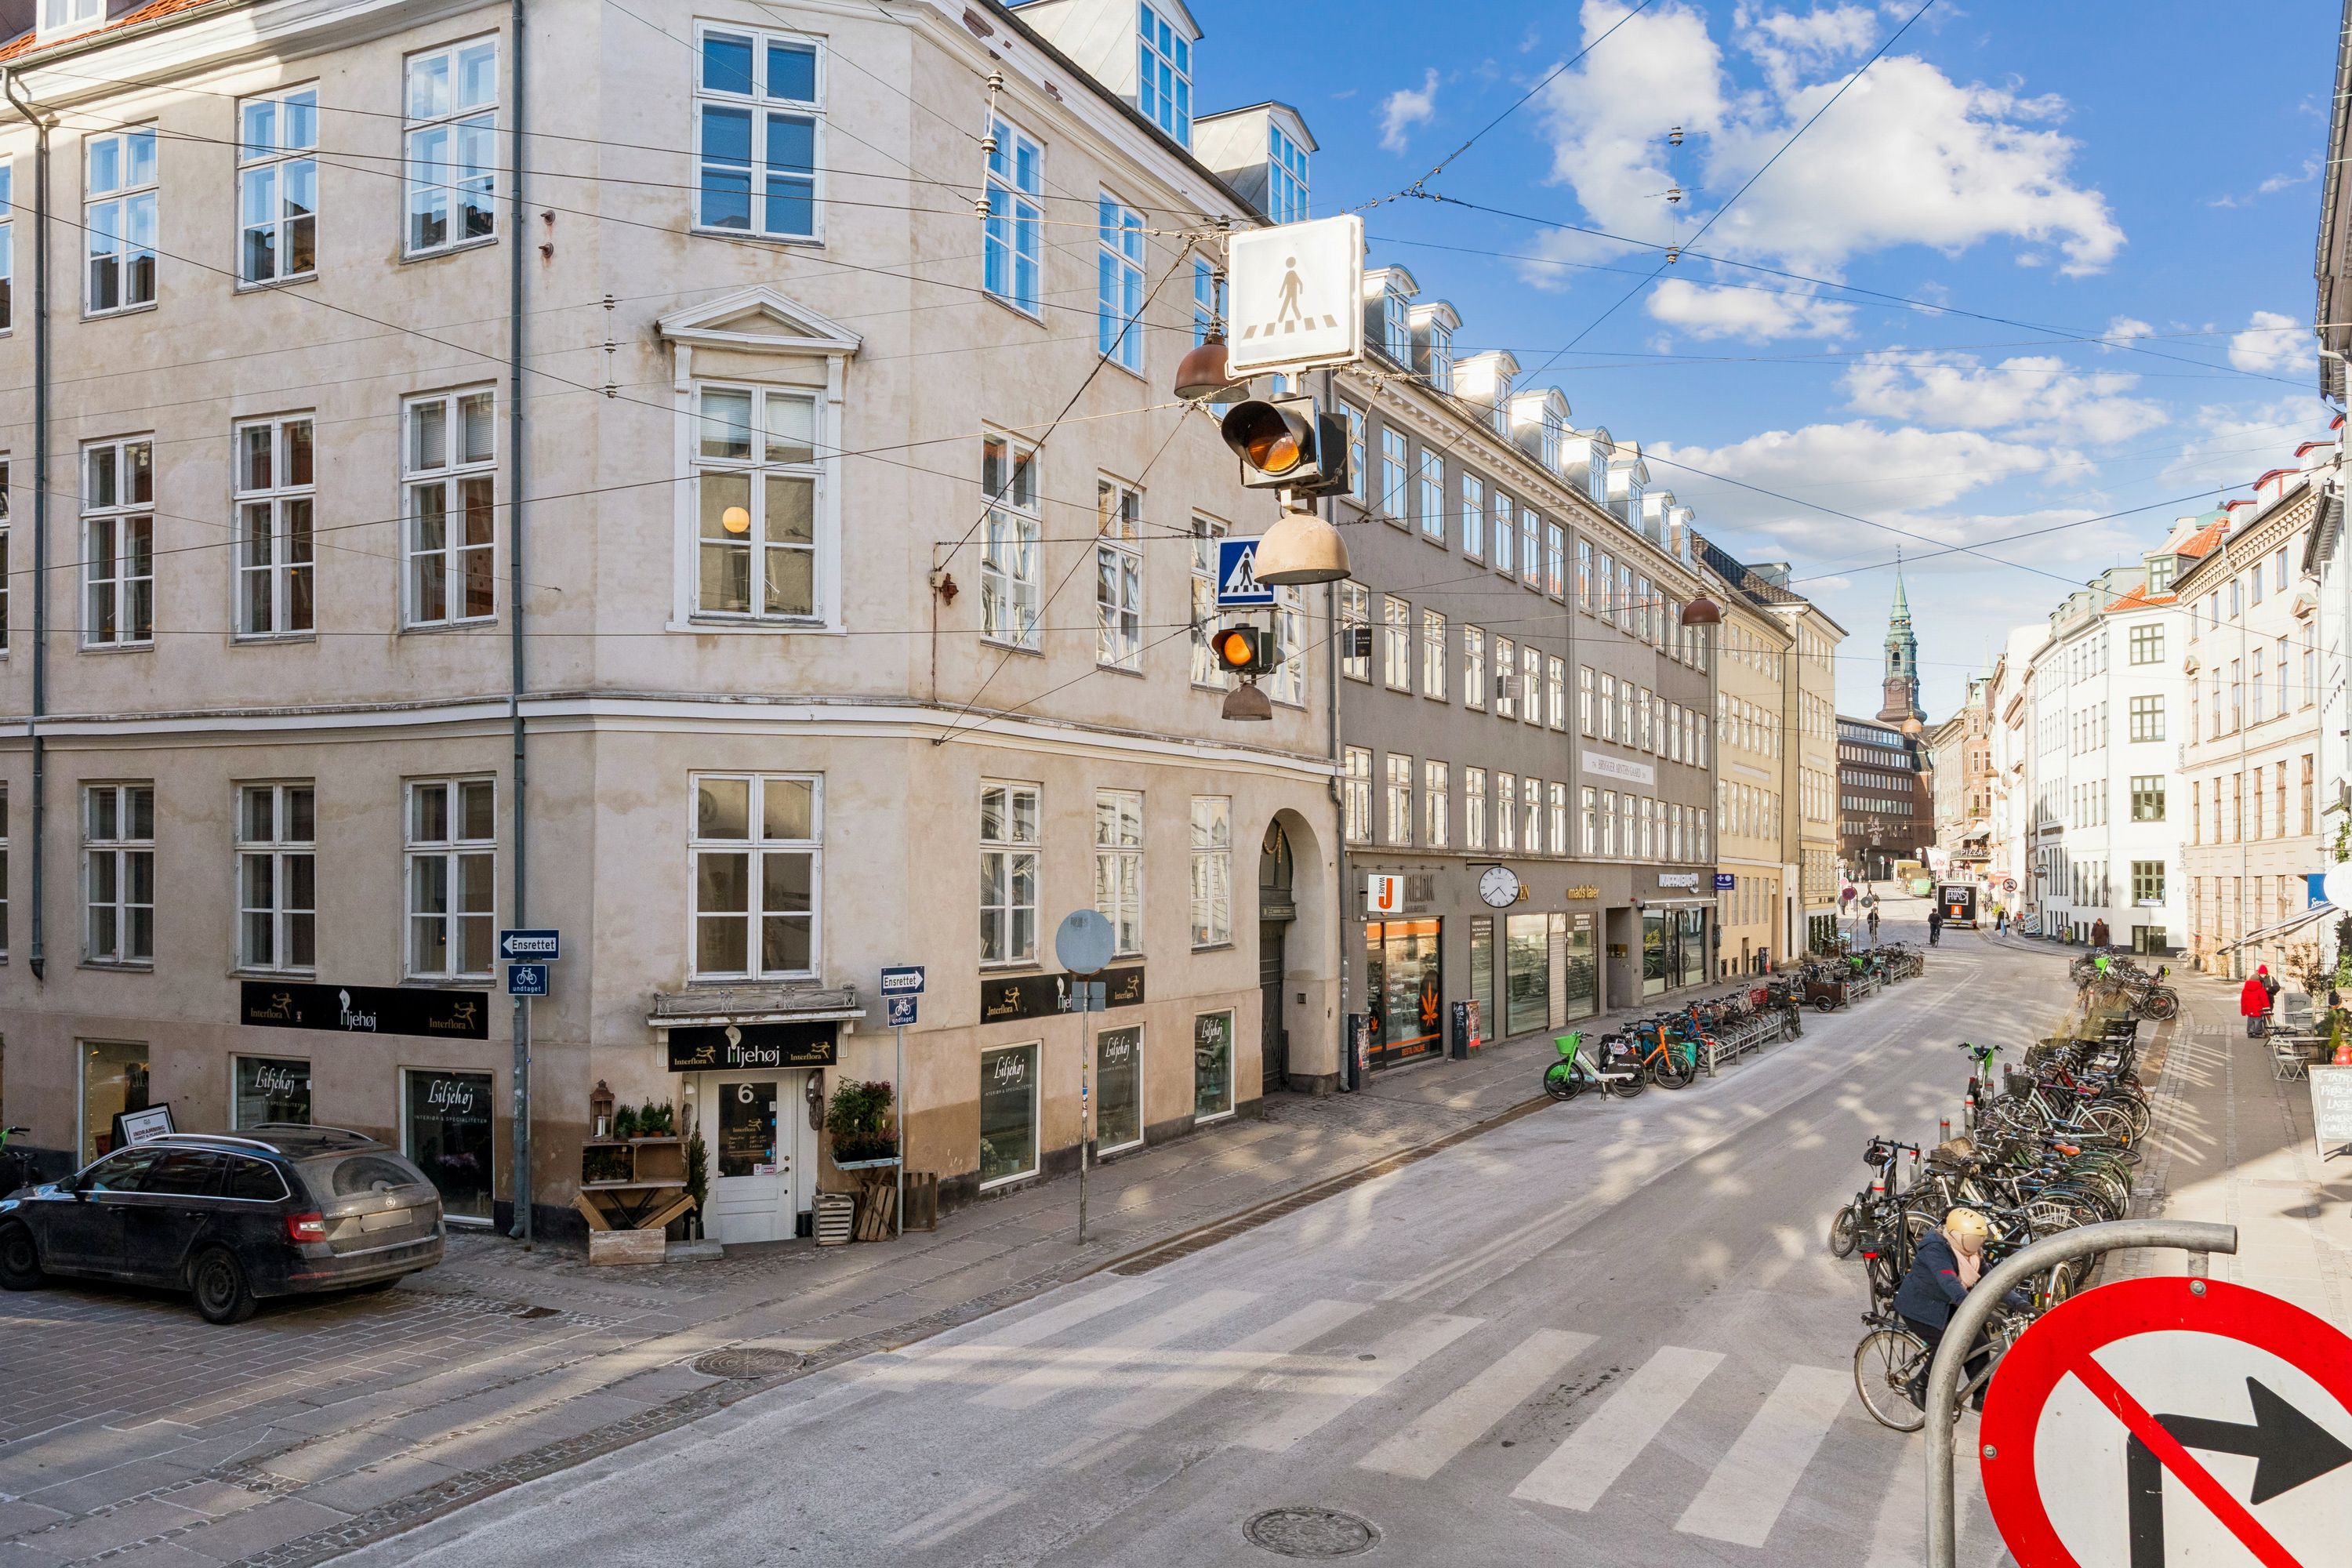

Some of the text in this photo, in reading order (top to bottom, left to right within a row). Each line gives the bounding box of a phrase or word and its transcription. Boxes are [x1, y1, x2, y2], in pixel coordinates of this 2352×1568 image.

[1378, 877, 1393, 909] J
[1568, 885, 1586, 898] mads
[2027, 924, 2039, 932] TEST
[512, 939, 554, 950] Ensrettet
[884, 975, 916, 987] Ensrettet
[1114, 989, 1134, 1000] Interflora
[1058, 993, 1073, 1014] liljeh
[251, 1007, 283, 1019] Interflora
[987, 1004, 1013, 1016] Interflora
[429, 1017, 466, 1029] Interflora
[891, 1015, 914, 1025] undtaget
[1105, 1036, 1130, 1064] Liljehøj
[674, 1057, 707, 1065] Interflora
[790, 1053, 822, 1062] Interflora
[993, 1054, 1025, 1086] Liljehøj
[254, 1065, 295, 1098] Liljehøj
[427, 1080, 474, 1114] Liljehøj
[738, 1083, 754, 1104] 6
[132, 1124, 165, 1138] INDRAMNING
